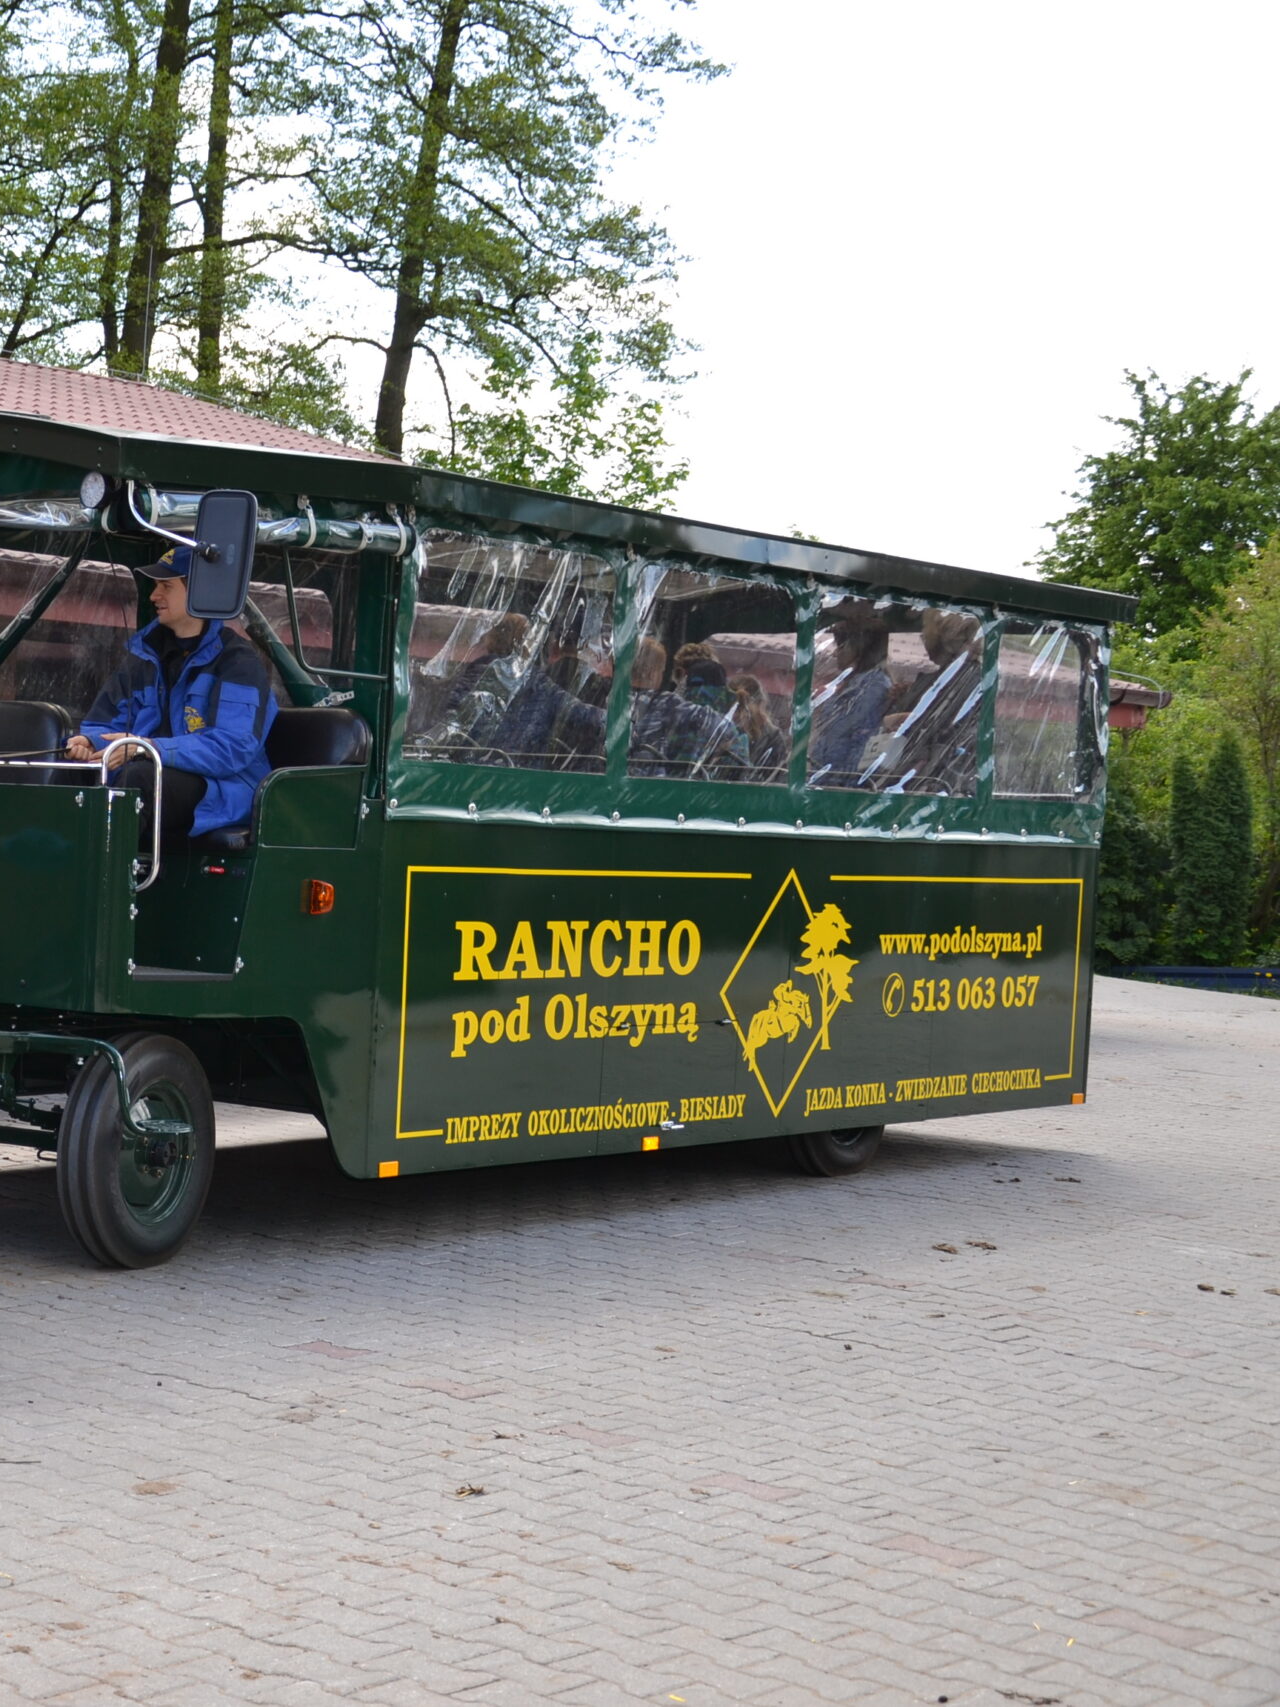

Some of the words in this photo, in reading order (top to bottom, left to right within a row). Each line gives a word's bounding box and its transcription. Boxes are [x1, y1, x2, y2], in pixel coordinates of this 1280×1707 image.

[453, 919, 702, 981] RANCHO
[879, 924, 1043, 962] www.podolszyna.pl
[910, 978, 953, 1013] 513
[956, 976, 998, 1011] 063
[1001, 974, 1041, 1009] 057
[450, 994, 532, 1059] pod
[543, 992, 701, 1049] Olszyną
[804, 1087, 843, 1117] JAZDA
[845, 1083, 886, 1108] KONNA
[895, 1074, 968, 1103] ZWIEDZANIE
[971, 1069, 1042, 1095] CIECHOCINKA
[445, 1112, 523, 1145] IMPREZY
[527, 1098, 671, 1137] OKOLICZNOŚCIOWE
[679, 1094, 747, 1123] BIESIADY
